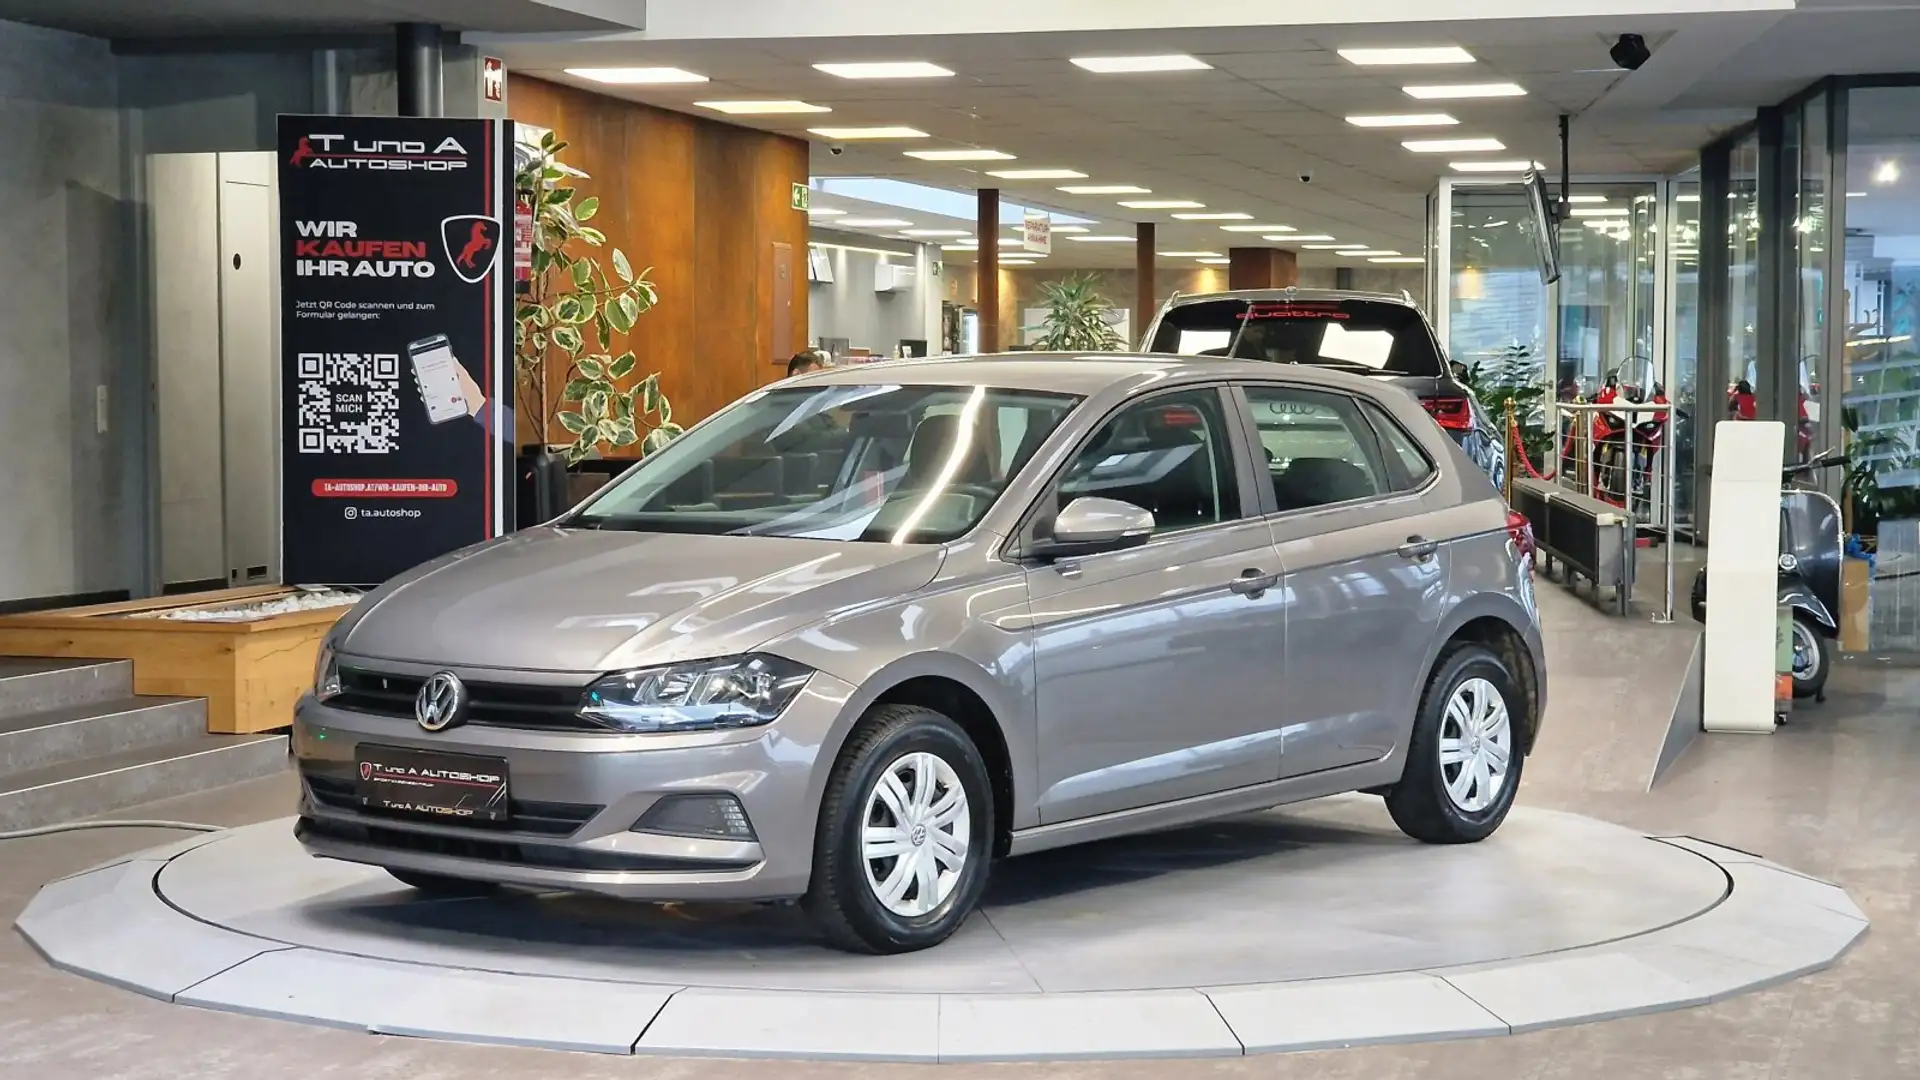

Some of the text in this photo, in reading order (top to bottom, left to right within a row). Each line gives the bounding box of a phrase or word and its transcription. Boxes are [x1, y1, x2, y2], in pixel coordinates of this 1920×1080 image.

[309, 134, 345, 151] T
[433, 136, 467, 154] A
[309, 159, 467, 171] AUTOSHOP
[295, 220, 358, 237] WIR
[296, 239, 427, 258] KAUFEN
[296, 260, 436, 278] IHR AUTO
[295, 301, 317, 309] Jetzt
[319, 301, 333, 310] QR
[334, 301, 357, 309] Code
[358, 302, 395, 310] scannen
[396, 302, 414, 310] und
[296, 310, 381, 321] Formular gelangen:
[336, 393, 363, 403] SCAN
[335, 404, 363, 413] MICH
[361, 508, 422, 519] ta.autoshop
[373, 763, 383, 771] T
[408, 767, 418, 775] A
[421, 769, 501, 783] AUTOSHOP
[383, 800, 391, 808] T
[405, 802, 412, 810] A
[415, 804, 474, 817] AUTOSHOP
